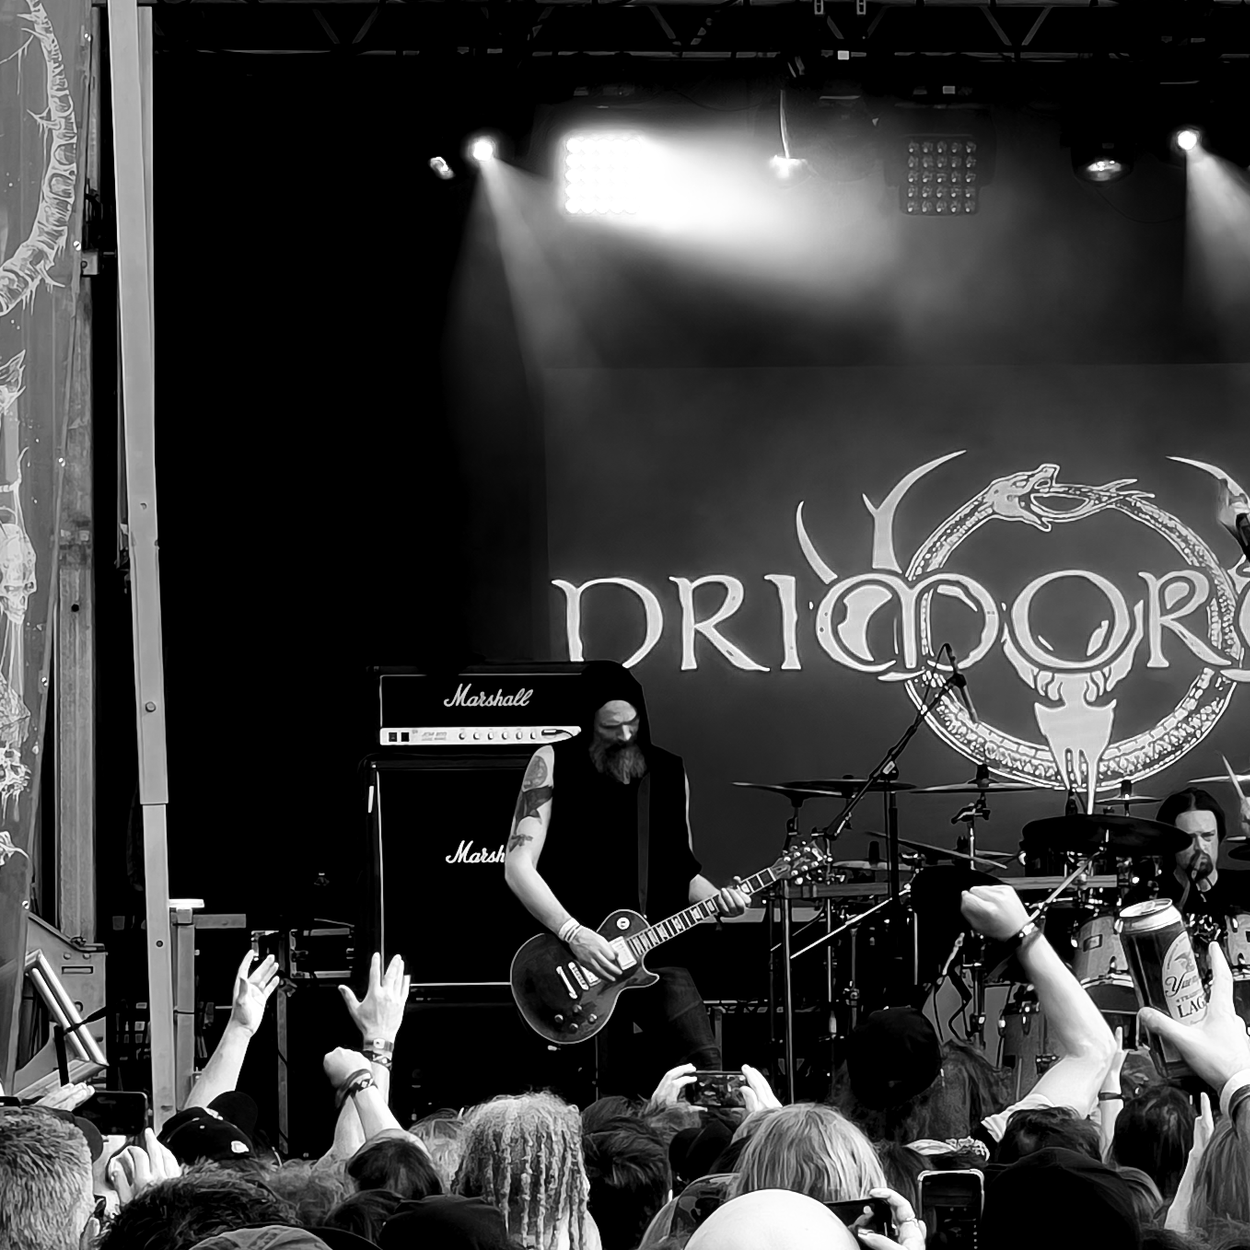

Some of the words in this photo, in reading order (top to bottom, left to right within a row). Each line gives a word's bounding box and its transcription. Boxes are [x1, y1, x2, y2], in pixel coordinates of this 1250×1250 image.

[444, 683, 533, 707] Marshall
[445, 840, 506, 863] Marsh
[1177, 996, 1207, 1018] LAG
